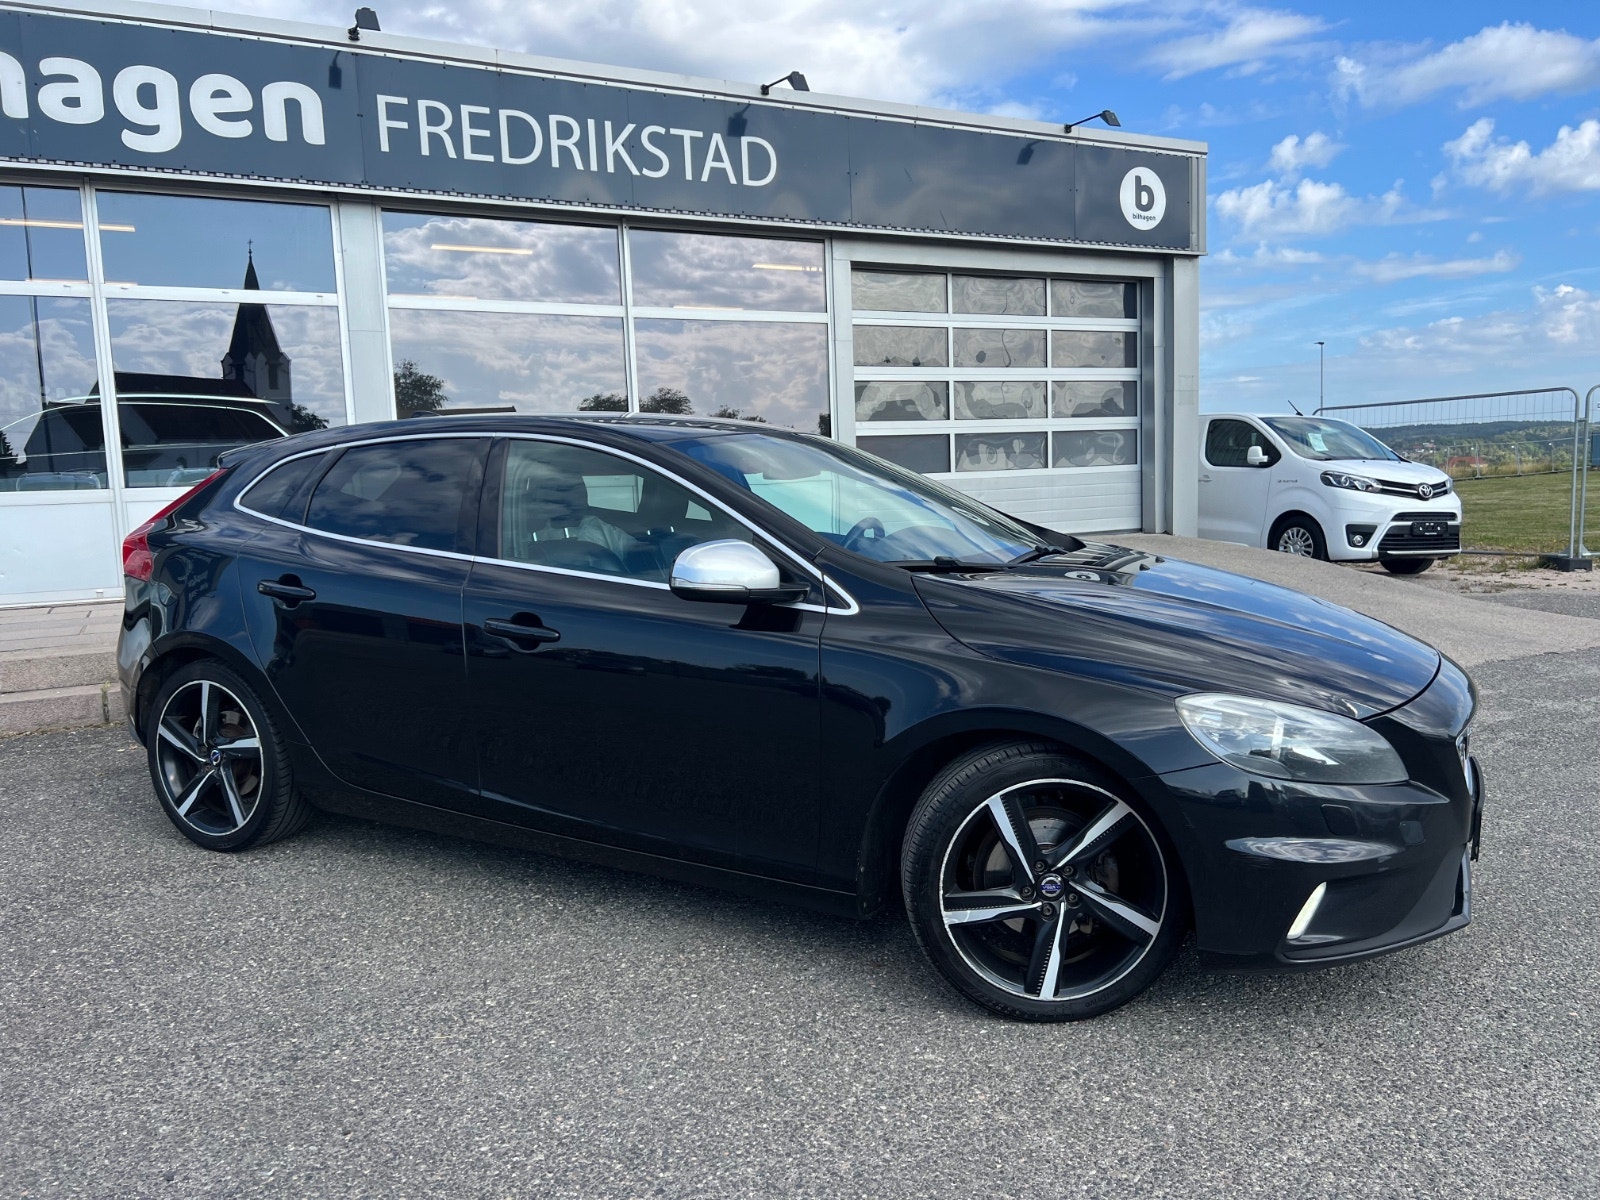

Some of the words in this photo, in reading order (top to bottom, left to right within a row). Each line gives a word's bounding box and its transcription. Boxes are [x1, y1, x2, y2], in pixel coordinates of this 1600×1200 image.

[376, 94, 777, 187] FREDRIKSTAD
[1134, 175, 1155, 212] b
[1132, 213, 1156, 221] bilhagen
